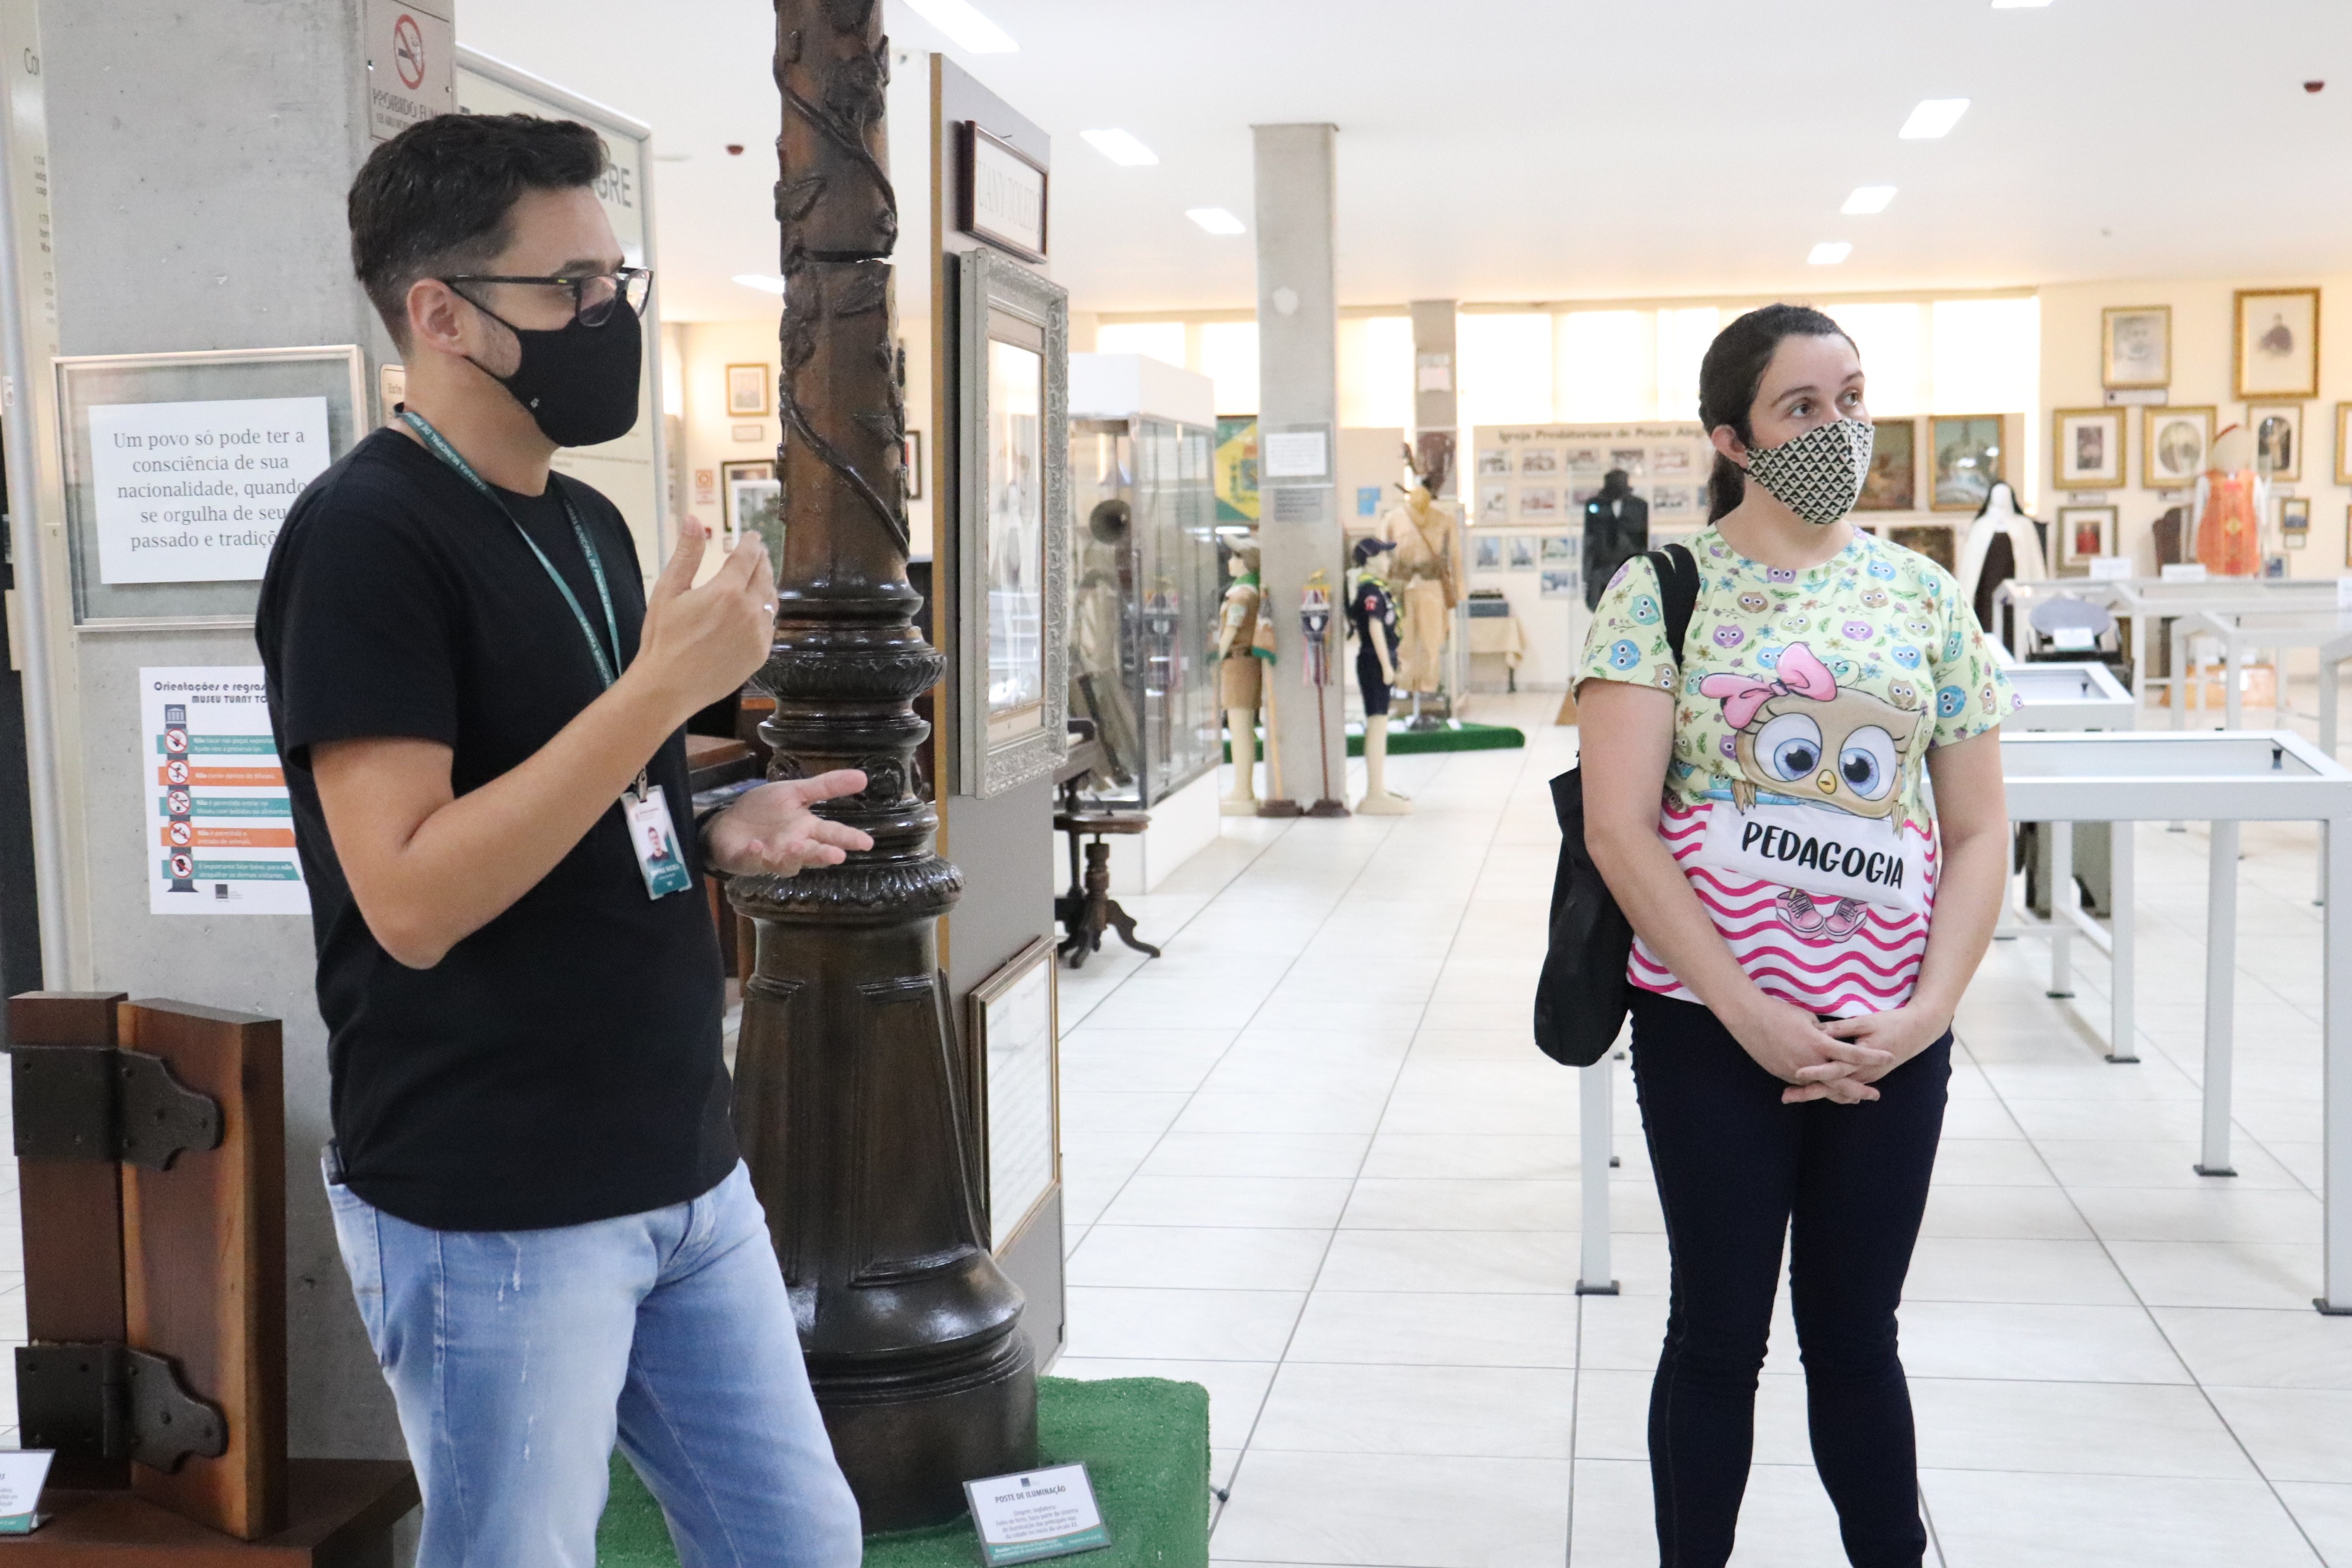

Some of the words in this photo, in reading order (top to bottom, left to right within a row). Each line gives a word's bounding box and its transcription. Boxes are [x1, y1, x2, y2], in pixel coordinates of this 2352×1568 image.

[595, 164, 632, 208] GRE
[114, 433, 142, 447] Um
[148, 434, 190, 450] povo
[195, 430, 214, 446] só
[219, 429, 260, 448] pode
[267, 430, 289, 443] ter
[295, 431, 305, 443] a
[420, 424, 432, 435] DE
[430, 432, 461, 466] MUNICIPAL
[132, 456, 229, 472] consciência
[234, 454, 254, 470] de
[260, 457, 289, 469] sua
[117, 480, 239, 498] nacionalidade,
[244, 478, 307, 498] quando
[141, 511, 158, 522] se
[163, 506, 228, 525] orgulha
[233, 505, 253, 520] de
[259, 508, 287, 520] seu
[130, 532, 199, 551] passado
[204, 535, 213, 546] e
[219, 530, 277, 548] tradiçõ
[594, 649, 612, 686] MUNICIPA
[154, 681, 220, 692] Orientações
[233, 683, 266, 694] regras
[1742, 821, 1904, 890] PEDAGOGIA
[994, 1492, 1015, 1503] POSTE
[1016, 1491, 1025, 1500] DE
[1025, 1484, 1066, 1498] ILUMINAÇÃO
